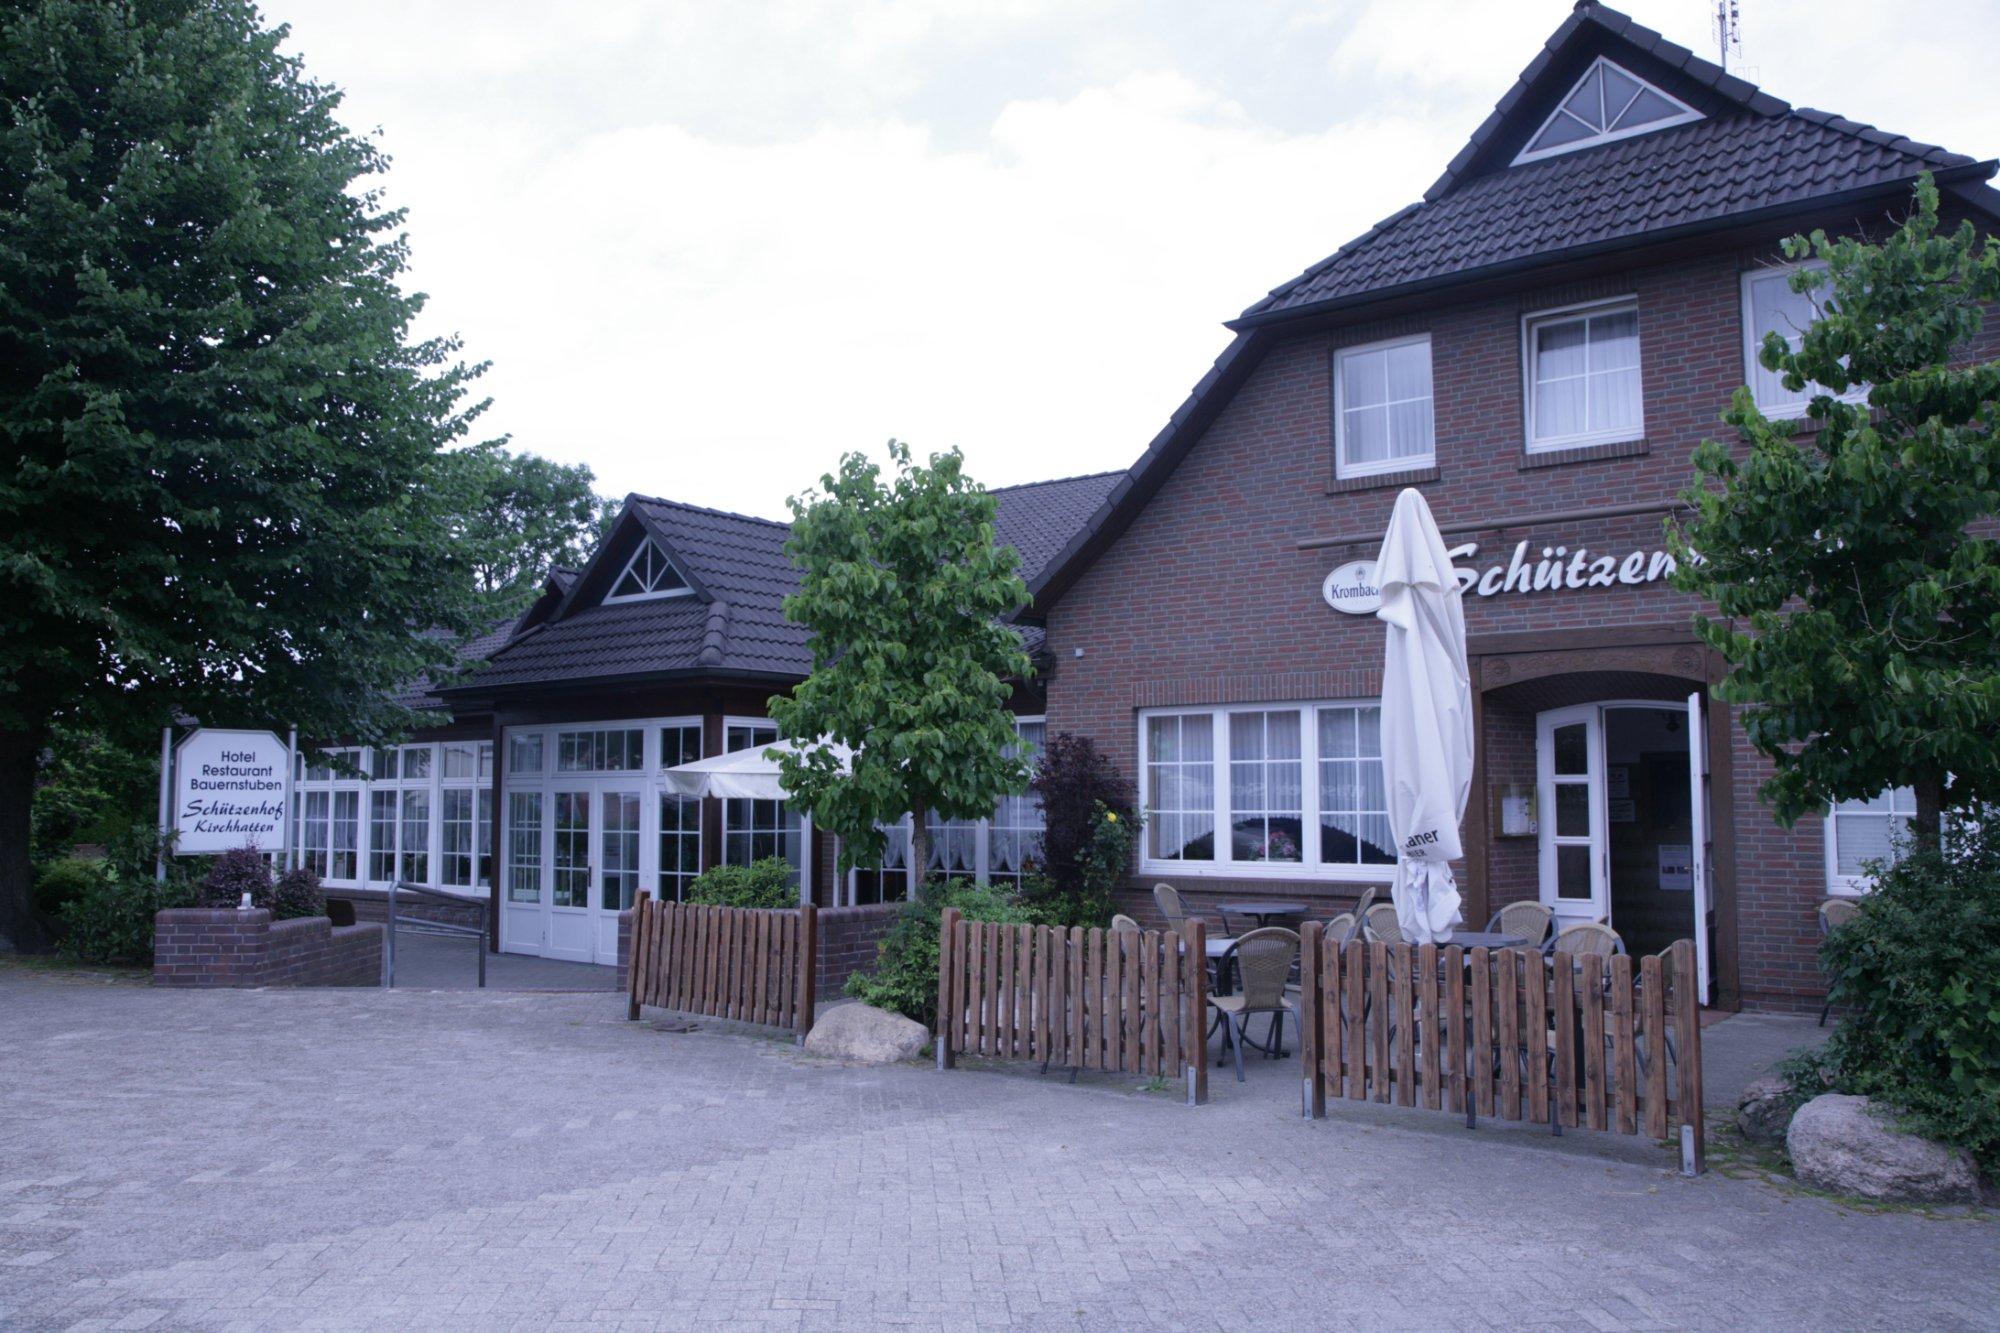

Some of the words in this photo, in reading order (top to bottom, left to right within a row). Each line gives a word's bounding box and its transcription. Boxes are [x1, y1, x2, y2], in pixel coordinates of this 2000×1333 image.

[221, 751, 256, 763] Hotel
[202, 764, 272, 777] Restaurant
[190, 779, 282, 791] Bauernstuben
[182, 799, 284, 821] Schützenhof
[194, 819, 274, 833] Kirchhatten
[1405, 829, 1439, 848] aner
